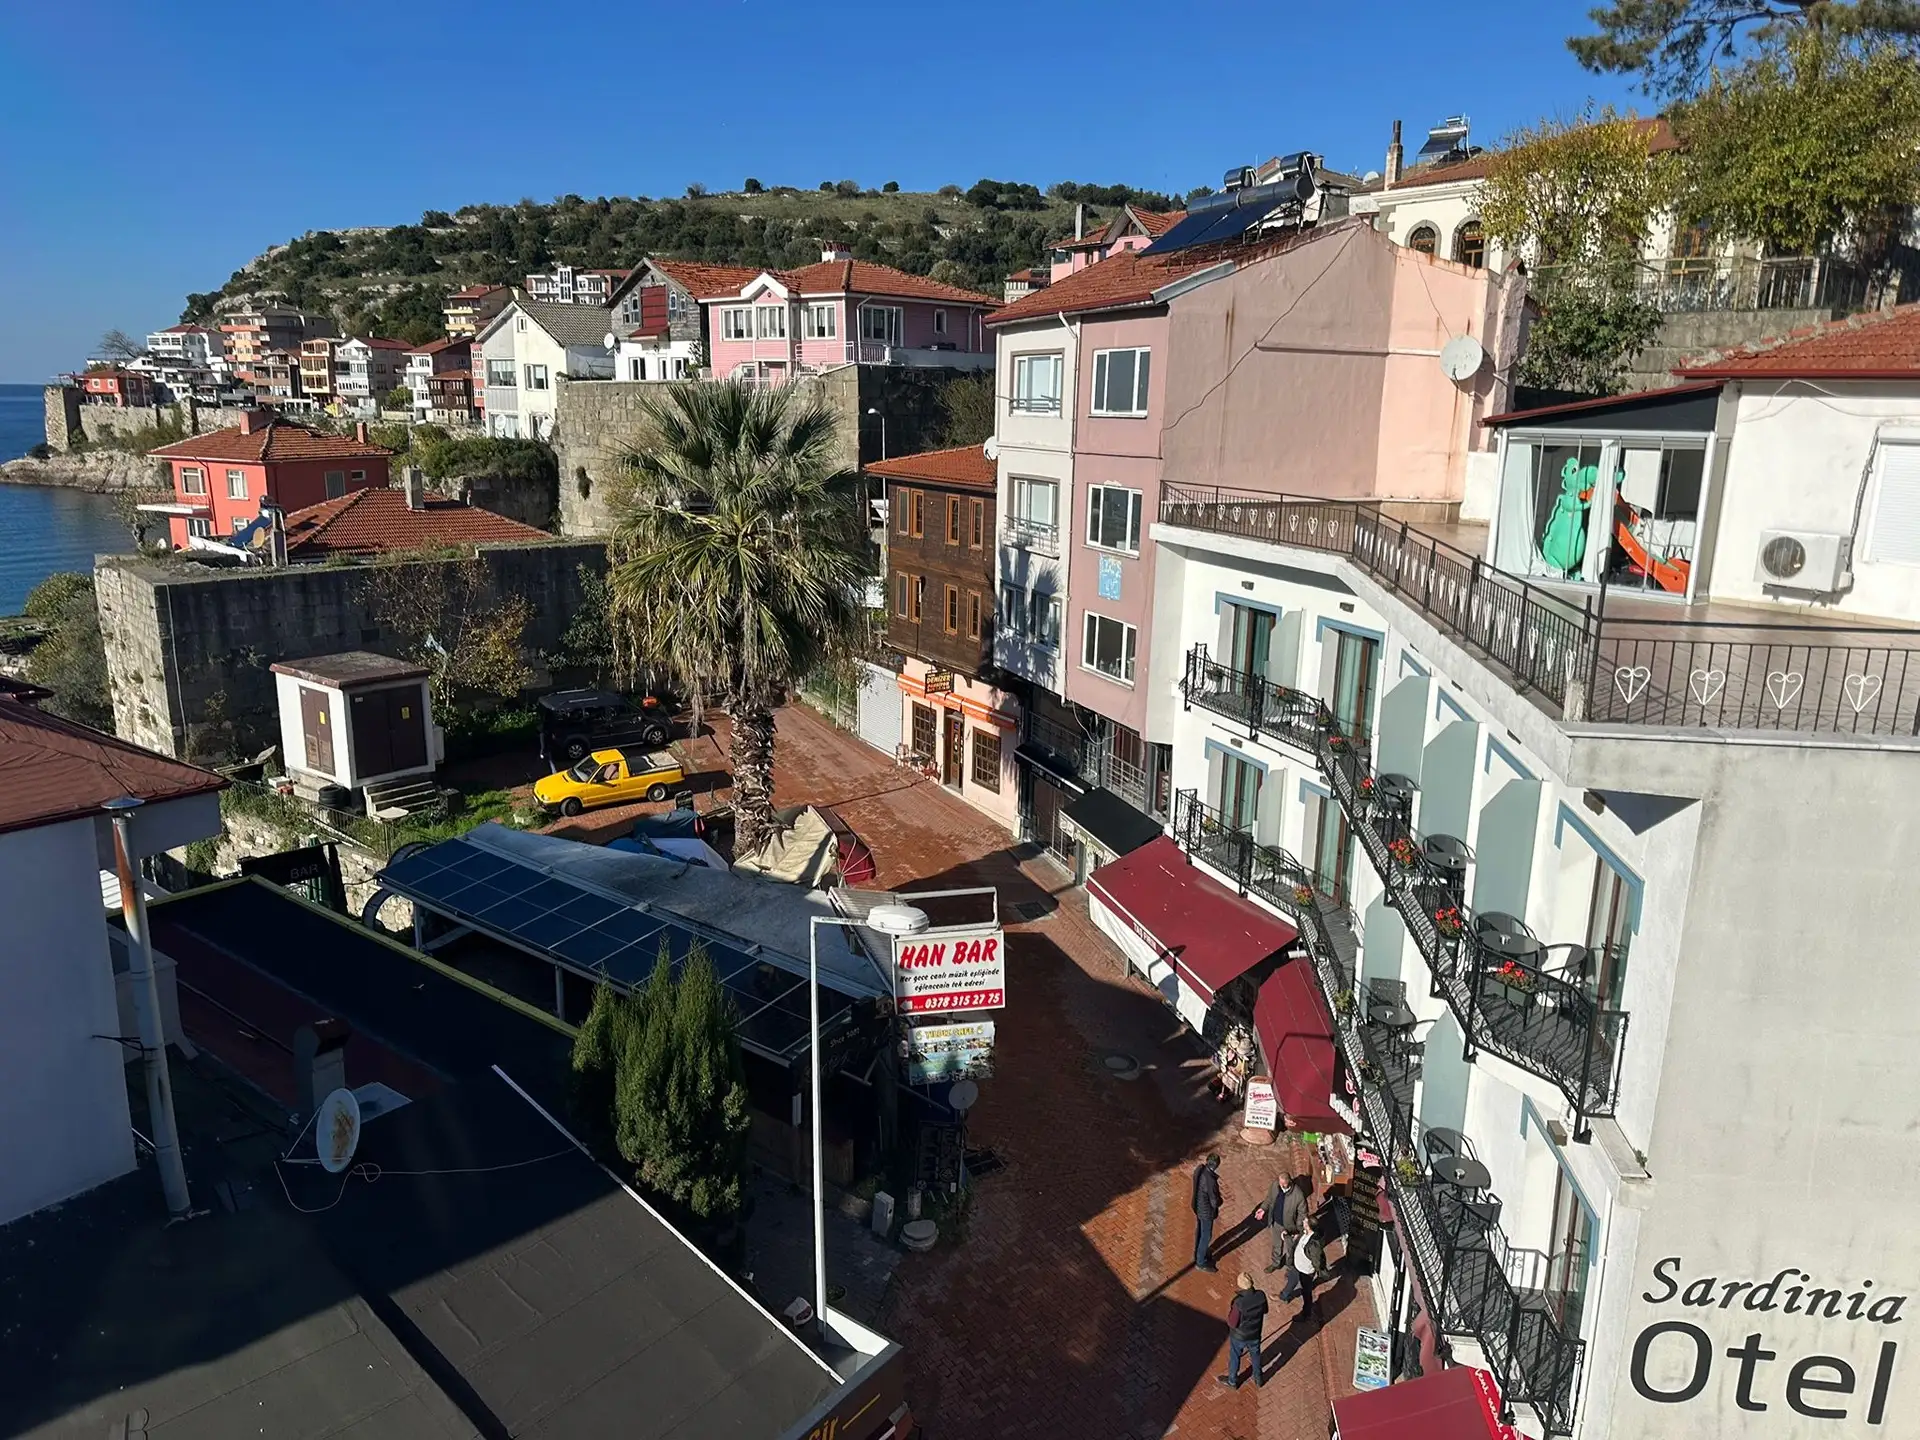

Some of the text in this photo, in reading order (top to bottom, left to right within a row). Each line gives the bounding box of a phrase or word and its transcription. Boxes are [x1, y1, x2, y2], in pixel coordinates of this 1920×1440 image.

[290, 863, 319, 879] BAR
[899, 938, 998, 969] HAN BAR
[913, 974, 928, 983] gece
[948, 970, 968, 978] müzik
[951, 980, 963, 988] tek
[924, 996, 950, 1009] 0378
[951, 994, 971, 1007] 315
[972, 993, 986, 1005] 27
[988, 992, 1001, 1004] 75
[1642, 1257, 1908, 1325] Sardinia
[1630, 1320, 1898, 1425] Otel
